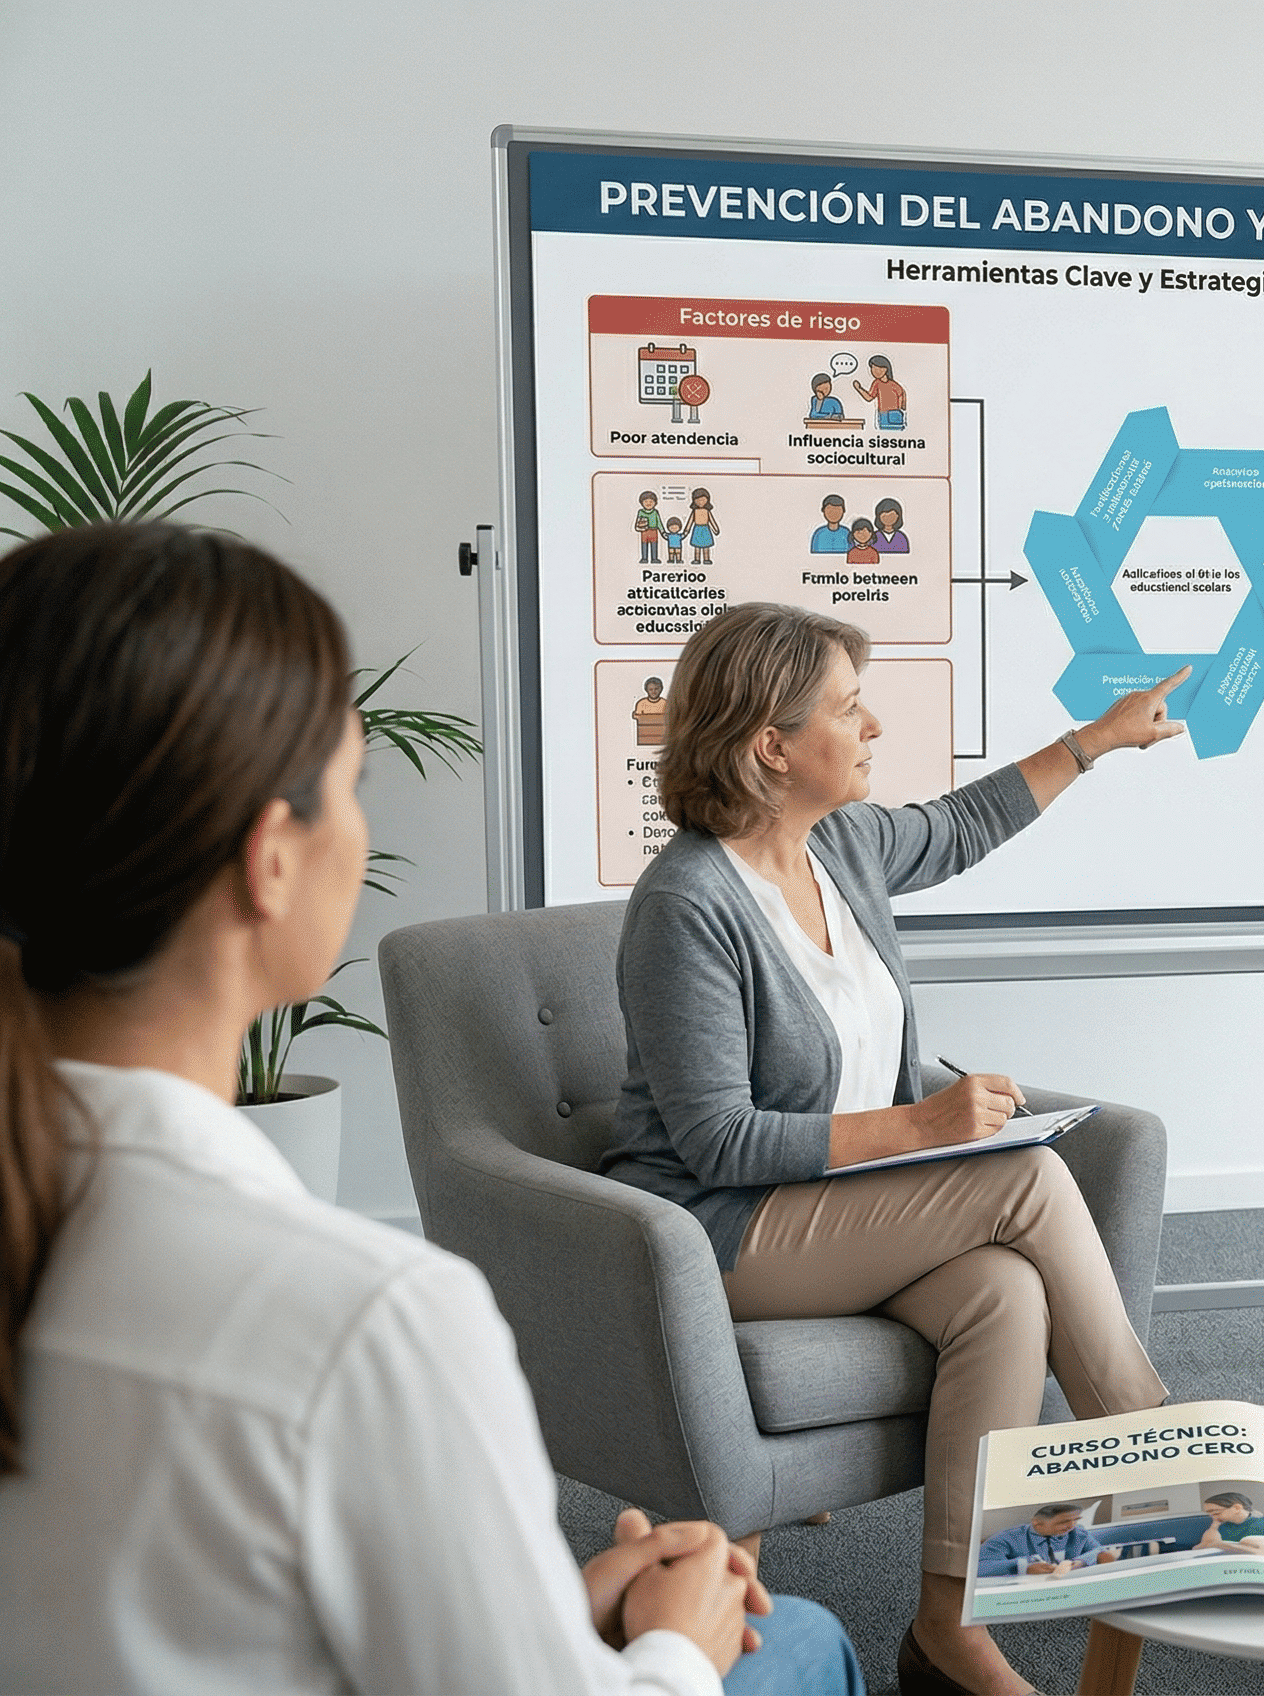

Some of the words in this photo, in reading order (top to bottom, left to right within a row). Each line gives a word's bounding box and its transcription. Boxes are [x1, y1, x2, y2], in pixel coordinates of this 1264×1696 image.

[600, 180, 884, 226] PREVENCIÓN
[901, 194, 980, 230] DEL
[992, 196, 1235, 240] ABANDONO
[886, 259, 1058, 286] Herramientas
[1065, 264, 1133, 288] Clave
[1139, 271, 1154, 294] y
[680, 307, 770, 329] Factores
[777, 311, 803, 330] de
[809, 312, 861, 333] risgo
[610, 430, 647, 446] Poor
[651, 431, 739, 447] atendencia
[788, 434, 864, 448] Influencia
[807, 451, 905, 466] sociocultural
[1031, 1437, 1120, 1459] CURSO
[1128, 1424, 1248, 1447] TÉCNICO:
[1026, 1446, 1180, 1477] ABANDONO
[1187, 1442, 1255, 1456] CERO
